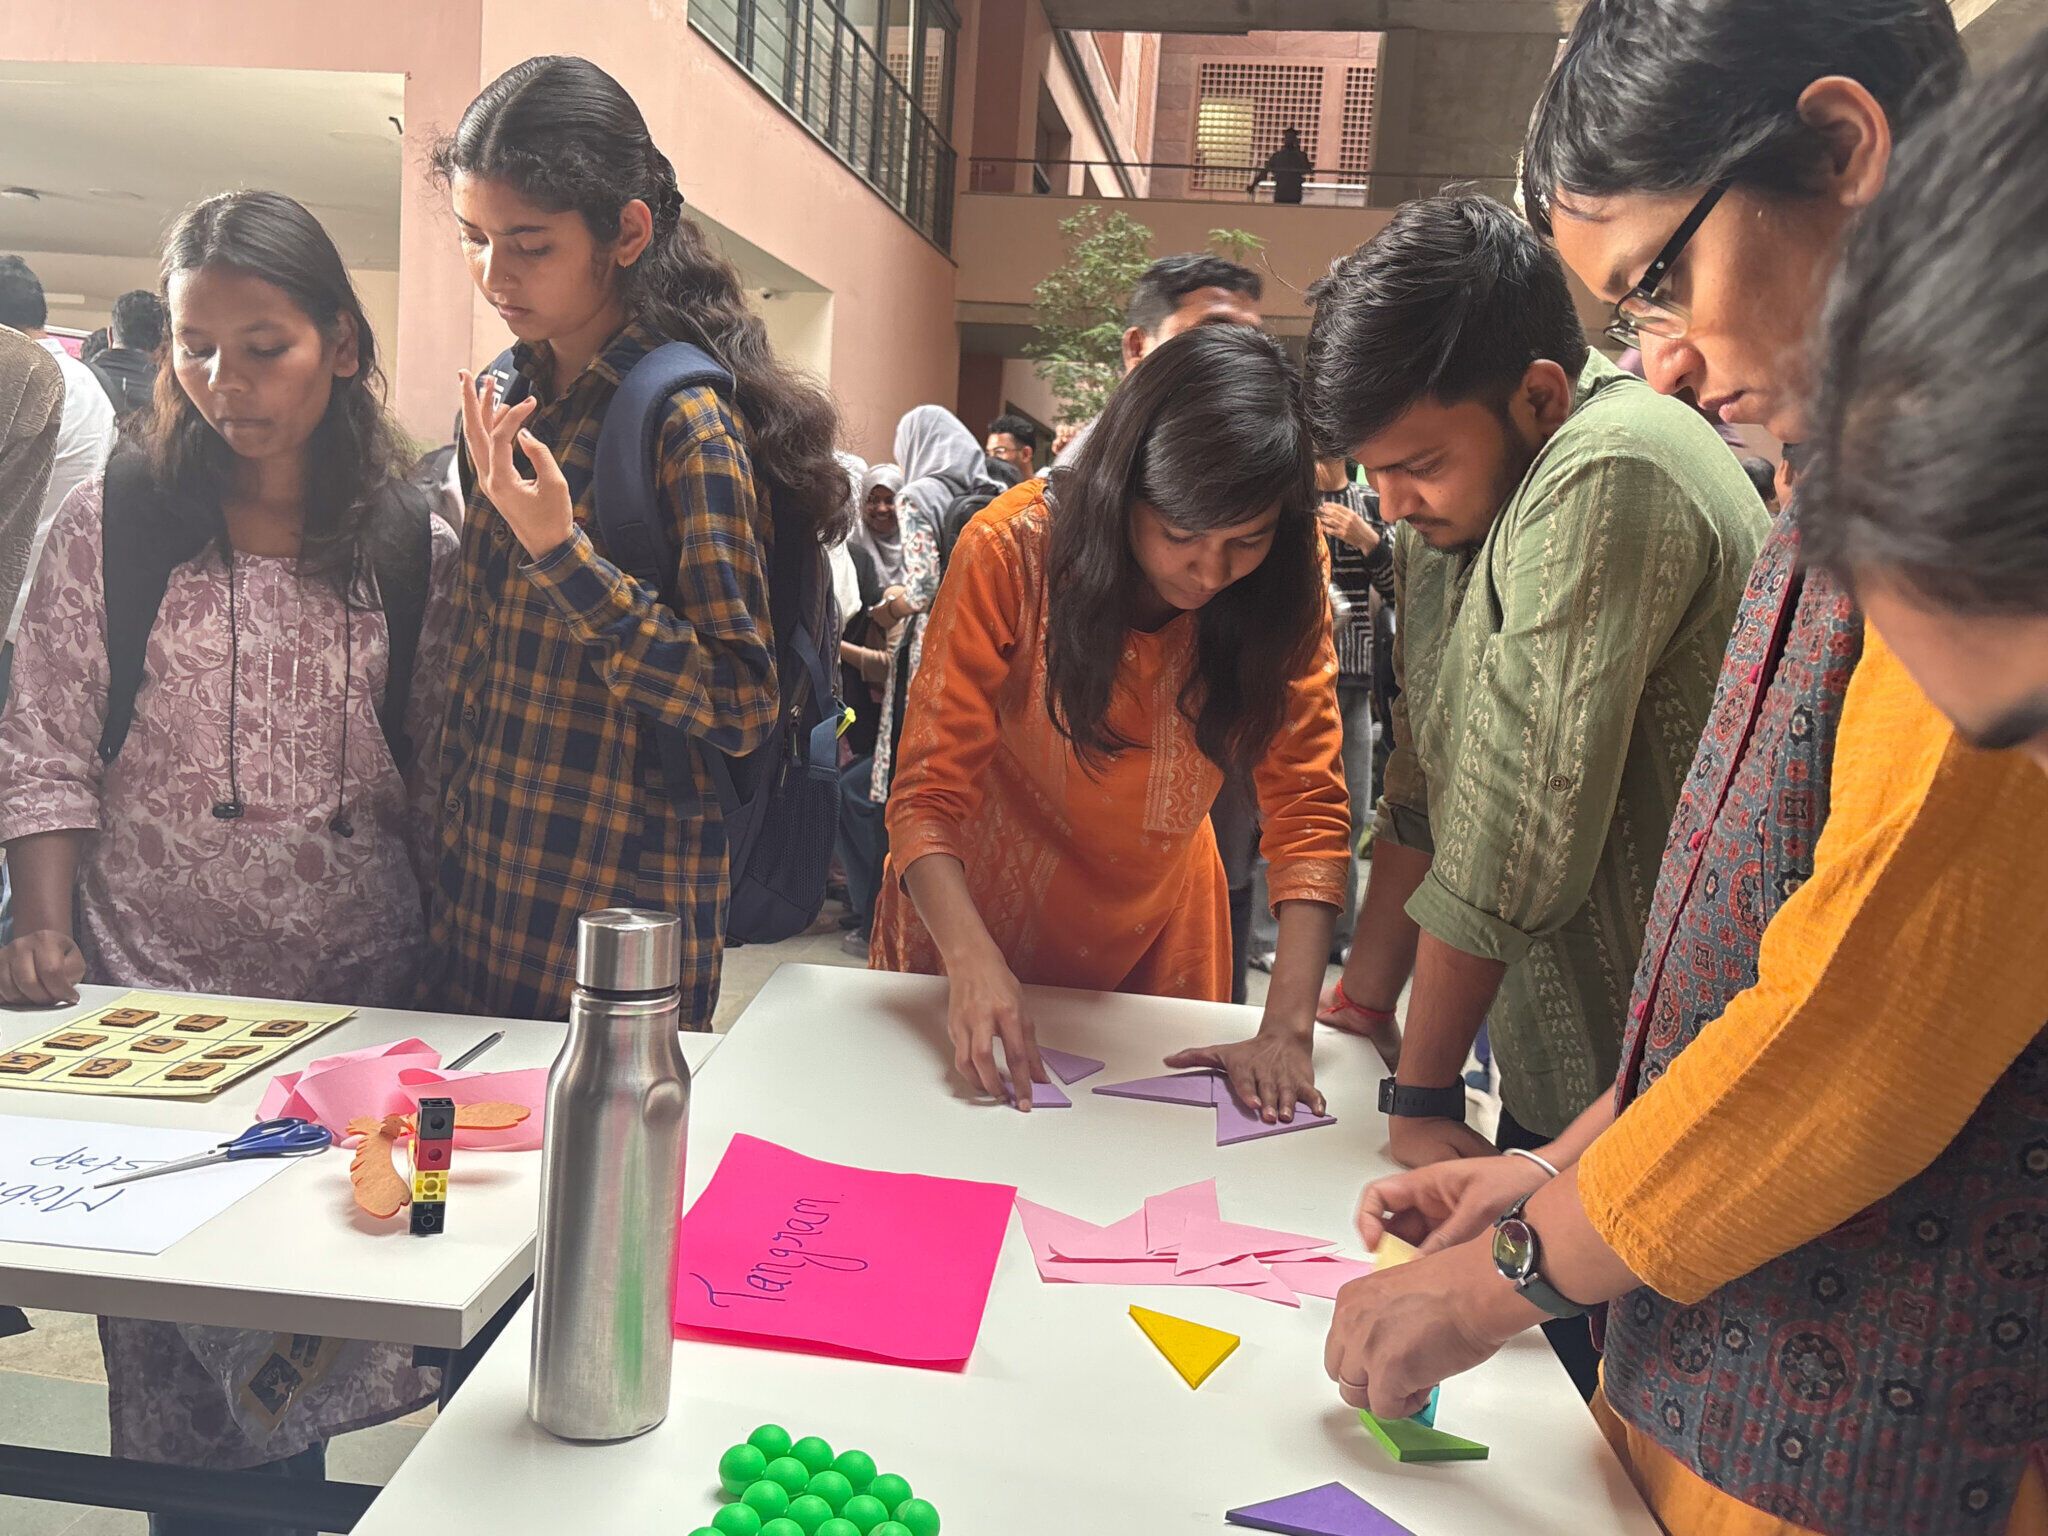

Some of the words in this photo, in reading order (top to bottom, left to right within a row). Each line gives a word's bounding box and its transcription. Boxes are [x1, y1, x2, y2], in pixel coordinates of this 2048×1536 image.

[492, 369, 510, 412] ari
[11, 1055, 41, 1064] 3
[86, 1058, 117, 1072] 8
[0, 1182, 126, 1213] Möb
